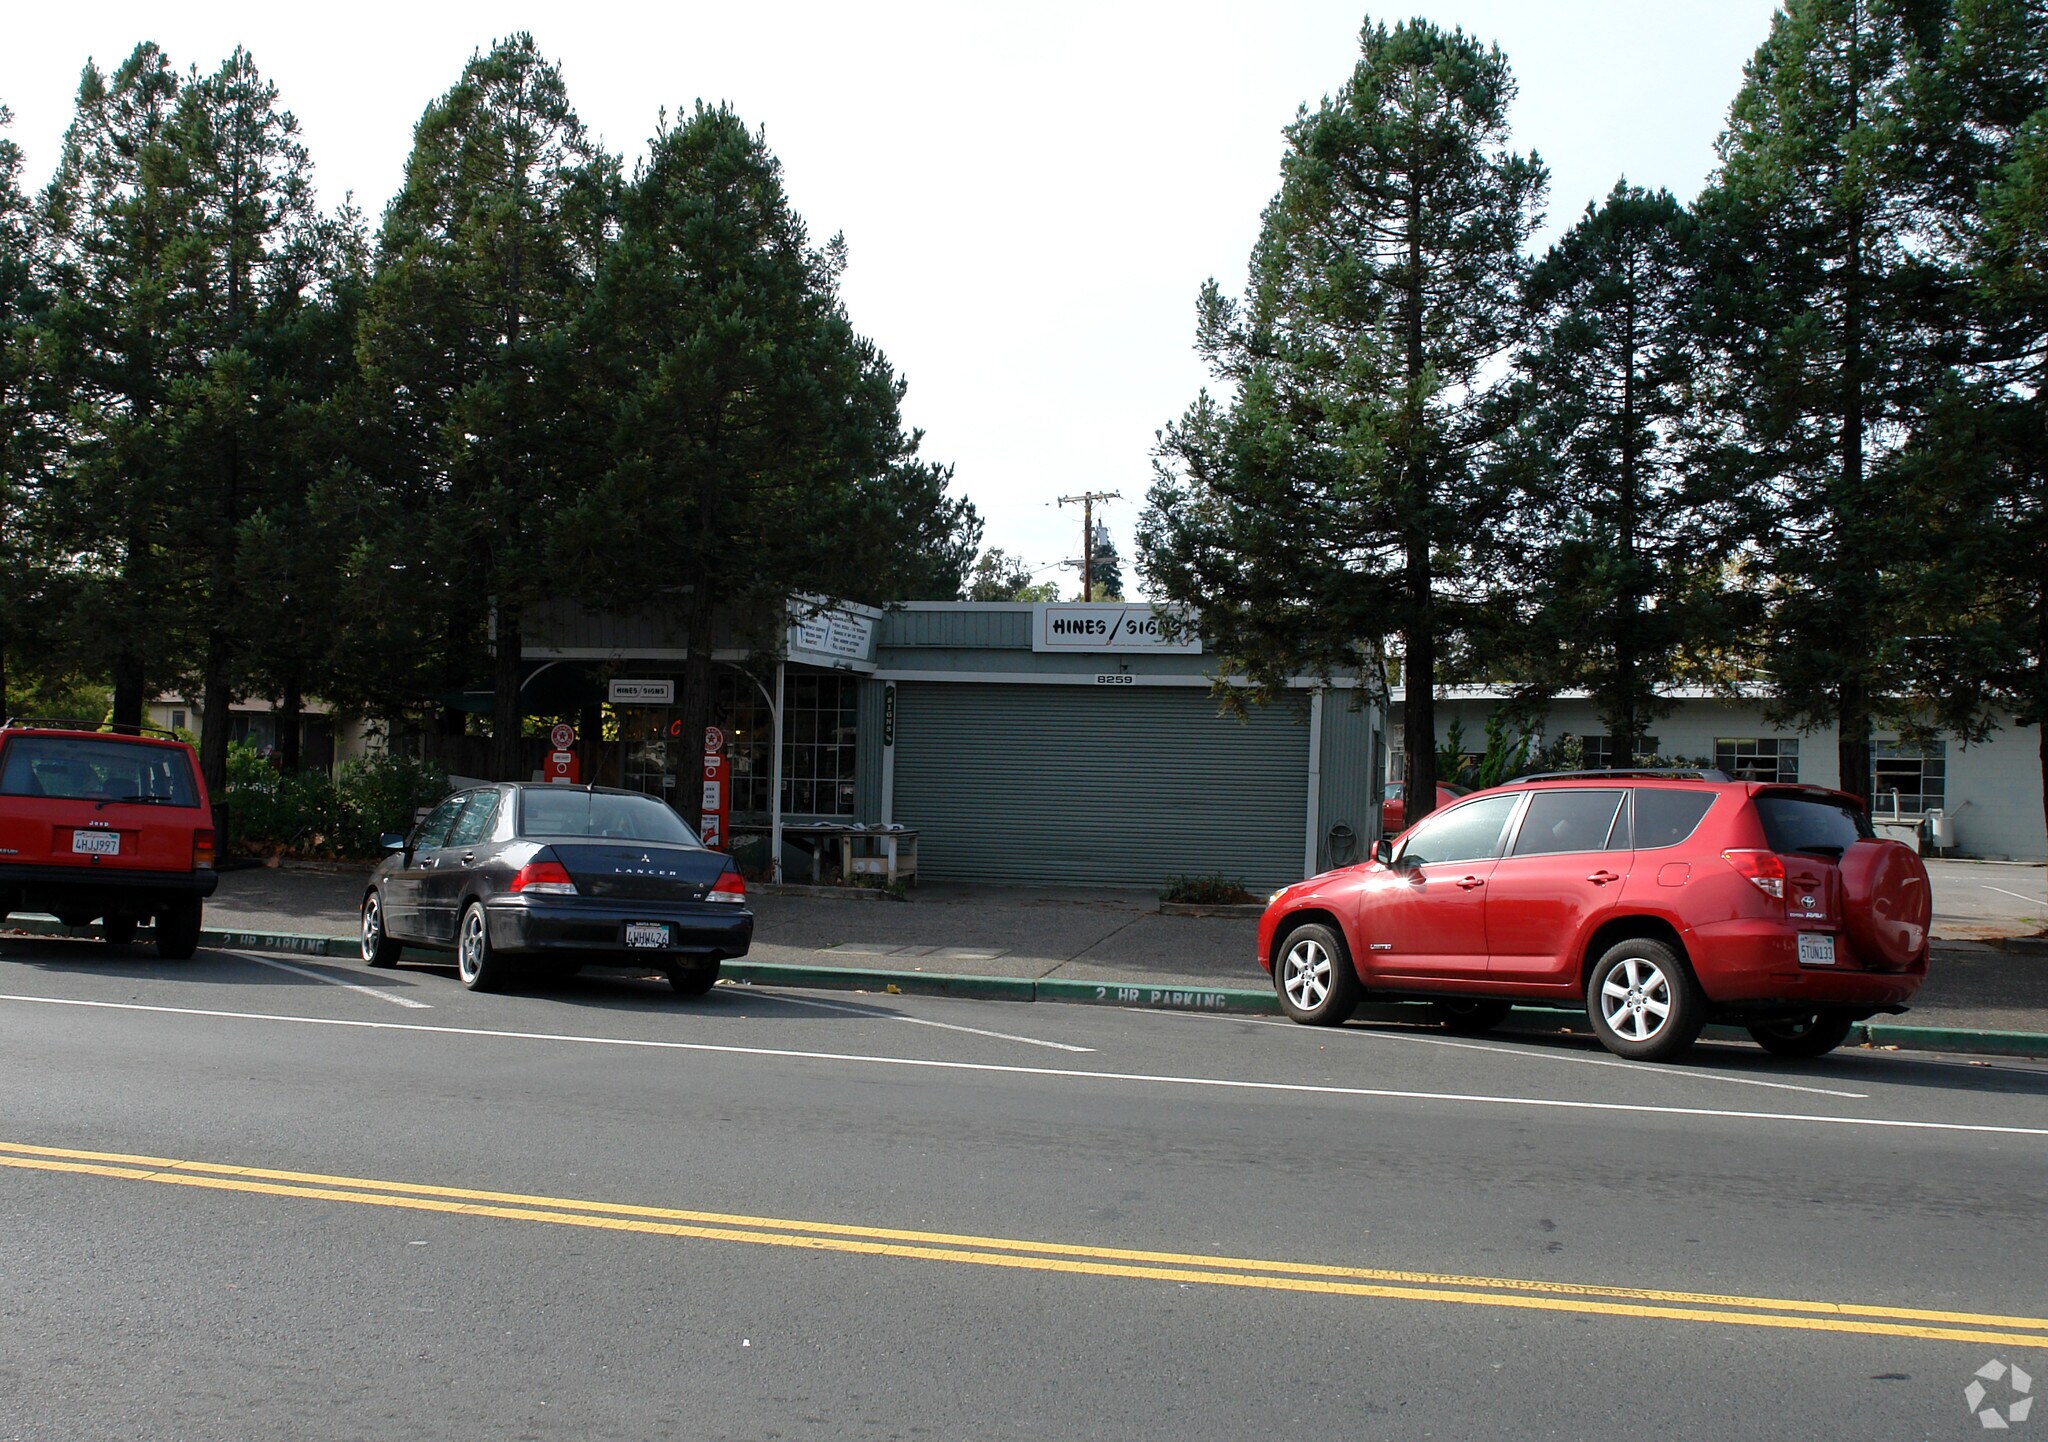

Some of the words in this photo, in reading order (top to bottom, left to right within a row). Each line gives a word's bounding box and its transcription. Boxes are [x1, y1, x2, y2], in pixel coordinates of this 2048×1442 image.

[1053, 619, 1106, 635] HINES
[1097, 676, 1133, 684] 8259
[75, 839, 117, 851] 4HJJ997
[615, 868, 676, 876] LANCER
[223, 934, 231, 944] 2
[240, 935, 257, 946] HR
[265, 937, 325, 953] PARKING
[628, 931, 668, 945] 4WHW426
[1801, 945, 1833, 960] 5TUN133
[1096, 987, 1107, 1000] 2
[1118, 988, 1140, 1003] HR
[1150, 990, 1226, 1008] PARKING
